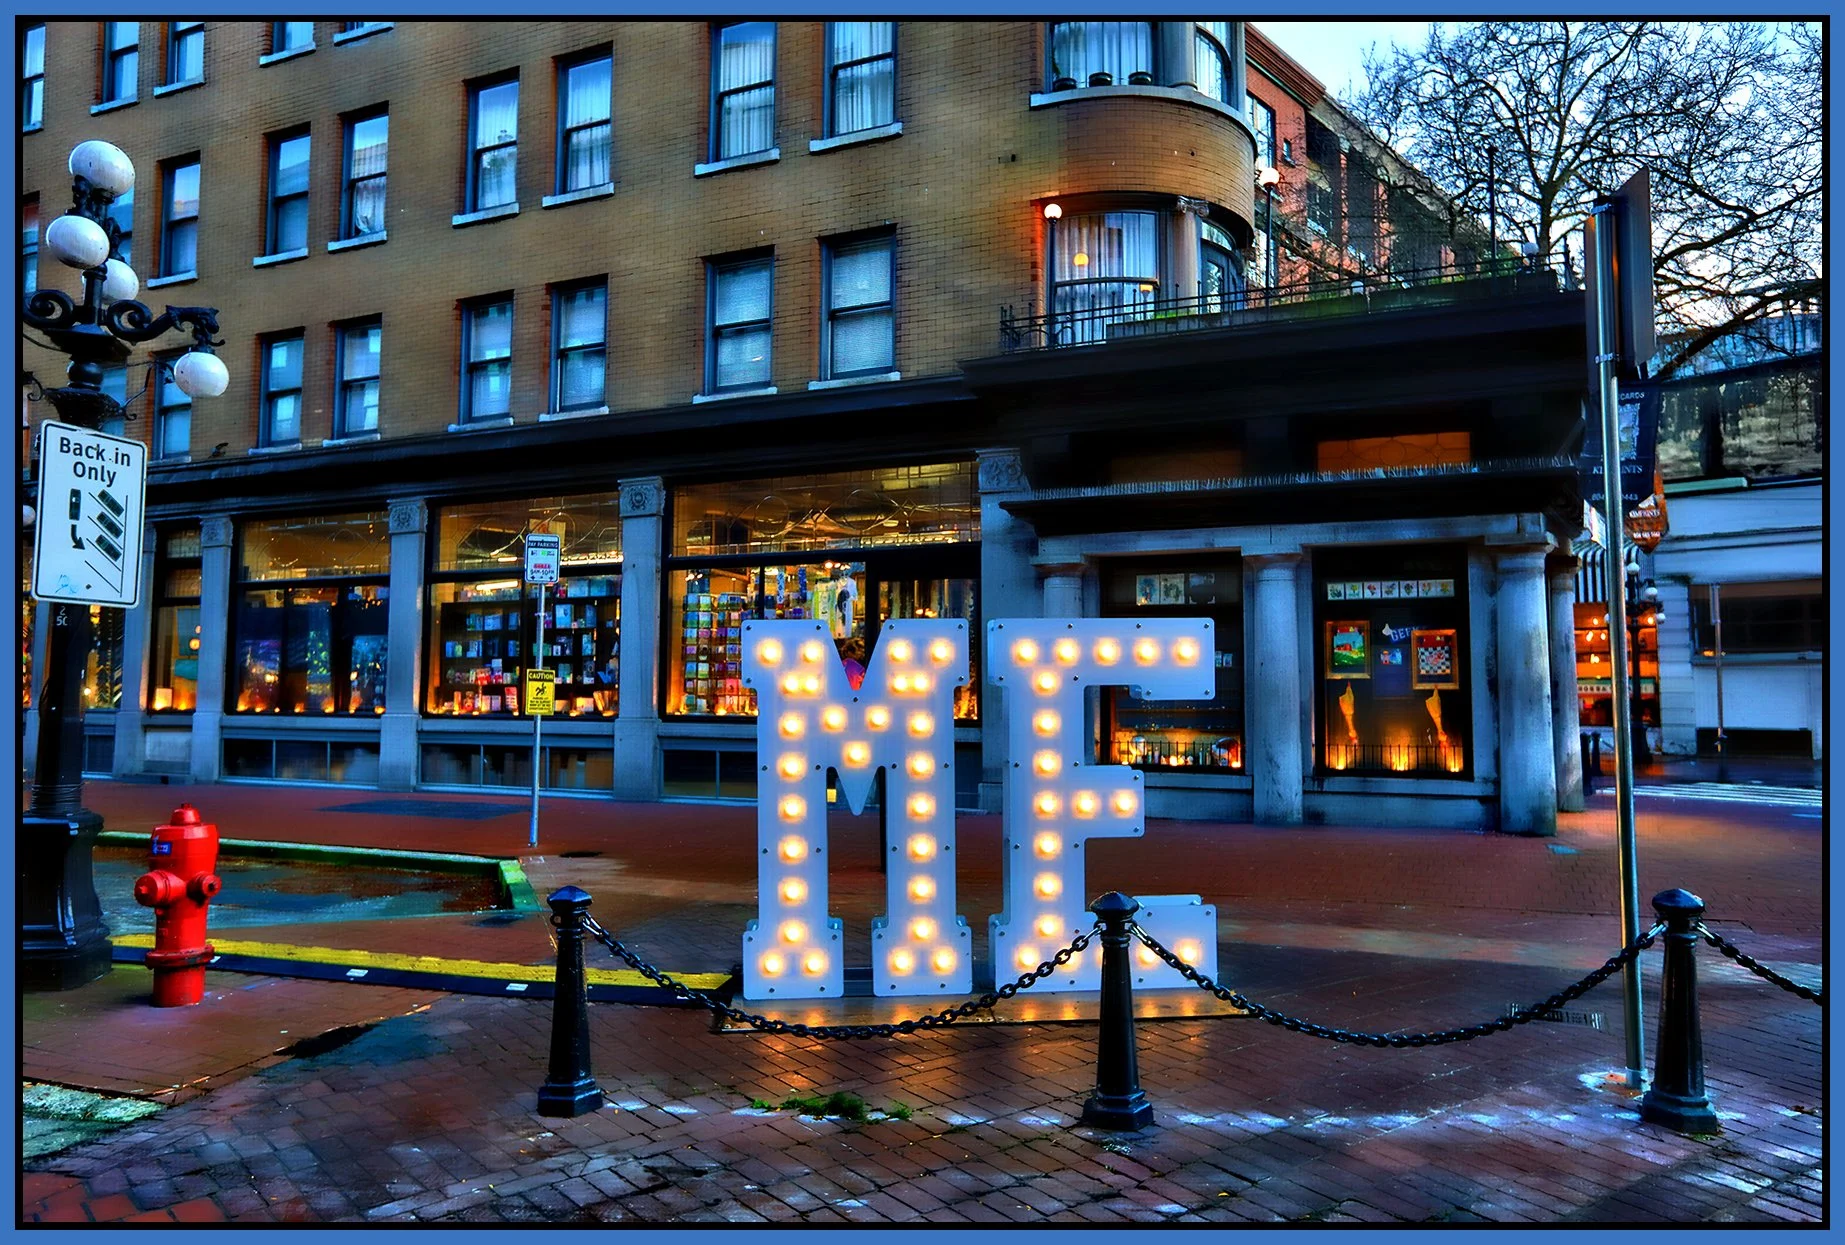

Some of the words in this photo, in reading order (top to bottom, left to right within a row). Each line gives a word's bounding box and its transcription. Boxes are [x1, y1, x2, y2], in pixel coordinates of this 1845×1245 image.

[59, 436, 106, 462] Back
[114, 447, 131, 467] in
[73, 460, 117, 488] Only
[528, 672, 554, 680] CAUTION
[740, 617, 1219, 1001] ME
